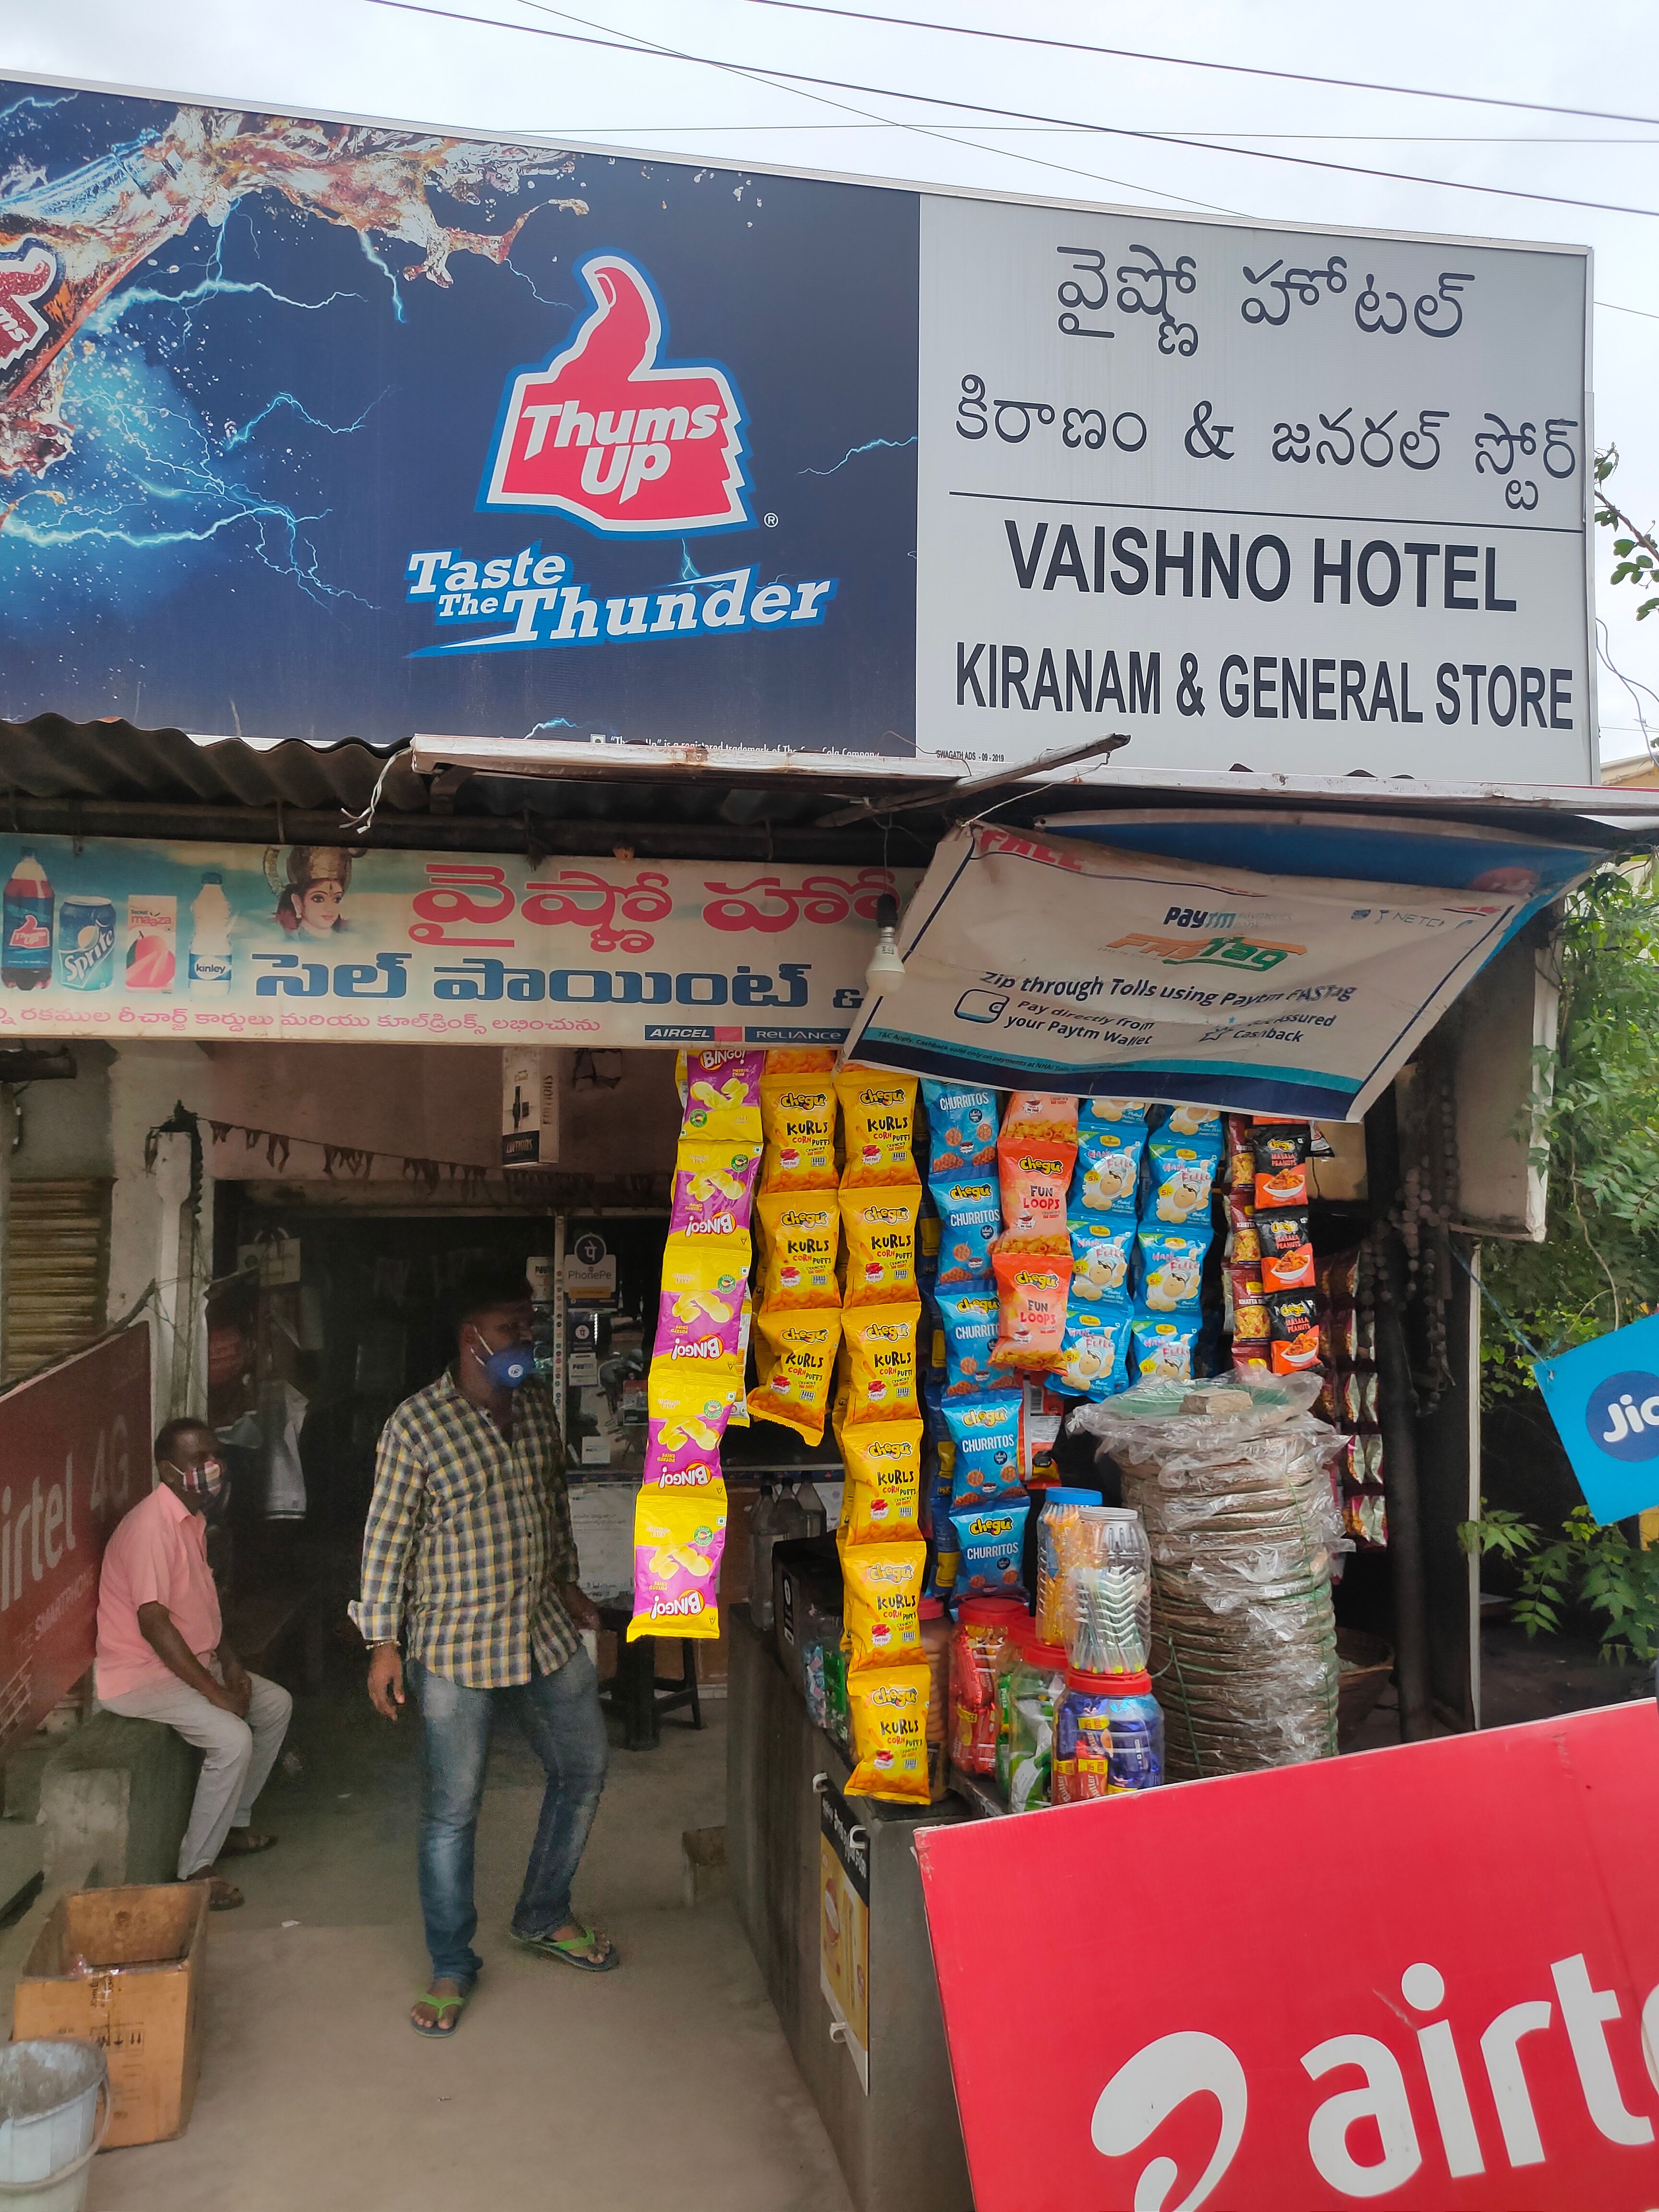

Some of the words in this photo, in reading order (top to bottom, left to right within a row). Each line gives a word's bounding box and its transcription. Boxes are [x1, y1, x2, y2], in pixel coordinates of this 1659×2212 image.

[1241, 256, 1475, 338] హోటల్
[521, 399, 721, 462] Thums
[956, 374, 1148, 452] కిరాణం
[1185, 400, 1235, 461] &
[1273, 407, 1449, 471] జనరల్
[1474, 413, 1577, 511] స్టోర్
[408, 542, 565, 594] Taste
[1004, 520, 1290, 603] VAISHNO
[1313, 538, 1517, 612] HOTEL
[439, 593, 497, 616] The
[499, 568, 830, 642] Thunder
[956, 641, 1160, 714] KIRANAM
[1177, 652, 1204, 716] &
[1219, 653, 1423, 724] GENERAL
[1436, 662, 1574, 730] STORE
[936, 749, 963, 759] SWAGATH
[964, 752, 976, 760] ADS
[131, 915, 172, 927] maaza
[64, 929, 113, 982] Sprite
[196, 963, 226, 974] kinley
[252, 952, 412, 1000] సెల్
[433, 957, 812, 1008] పాయింట్
[979, 971, 1015, 989] Zip
[1020, 974, 1104, 1002] through
[1110, 977, 1158, 997] Tolls
[1160, 985, 1220, 1007] using
[1219, 992, 1286, 1008] Paytm
[20, 1007, 111, 1022] రకముల
[280, 1012, 371, 1028] మరియు
[1017, 999, 1049, 1015] Pay
[1051, 1004, 1113, 1029] directly
[649, 1028, 710, 1038] AIRCEL
[1004, 1014, 1045, 1034] your
[1048, 1020, 1100, 1041] Paytm
[1104, 1030, 1154, 1047] Wallet
[702, 1050, 745, 1069] BINGO!
[878, 1031, 893, 1040] T&C
[916, 1038, 949, 1052] Cashback
[949, 1046, 965, 1055] valid
[965, 1049, 984, 1061] only
[992, 1056, 1026, 1068] payments
[1035, 1062, 1054, 1071] NHAI
[939, 1092, 989, 1111] CHURRITOS
[786, 1120, 828, 1136] KURLS
[867, 1116, 908, 1133] KURLS
[792, 1135, 812, 1144] CORN
[873, 1131, 892, 1140] CORN
[1030, 1185, 1053, 1197] FUN
[1023, 1198, 1060, 1210] LOOPS
[685, 1214, 733, 1238] BINGO!
[950, 1209, 1000, 1226] CHURRITOS
[787, 1238, 830, 1254] KURLS
[871, 1233, 911, 1250] KURLS
[1276, 1241, 1301, 1250] PEANUTS
[793, 1253, 812, 1262] CORN
[877, 1249, 895, 1257] CORN
[568, 1269, 612, 1280] PhonePe
[1027, 1299, 1048, 1312] FUN
[1020, 1311, 1057, 1325] LOOPS
[1287, 1323, 1311, 1334] PEANUTS
[671, 1337, 720, 1360] BINGO!
[785, 1352, 824, 1369] KURLS
[874, 1351, 912, 1368] KURLS
[788, 1367, 806, 1376] CORN
[805, 1373, 823, 1381] PUFFS
[962, 1434, 1015, 1454] CHURRITOS
[659, 1465, 709, 1489] BINGO!
[877, 1469, 914, 1486] KURLS
[882, 1485, 900, 1494] CORN
[900, 1488, 916, 1496] PUFFS
[966, 1541, 1019, 1561] CHURRITOS
[650, 1592, 701, 1620] BINGO!
[877, 1593, 916, 1611] KURLS
[883, 1610, 902, 1618] CORN
[880, 1718, 919, 1736] KURLS
[887, 1735, 905, 1744] CORN
[1299, 1952, 1659, 2199] airt
